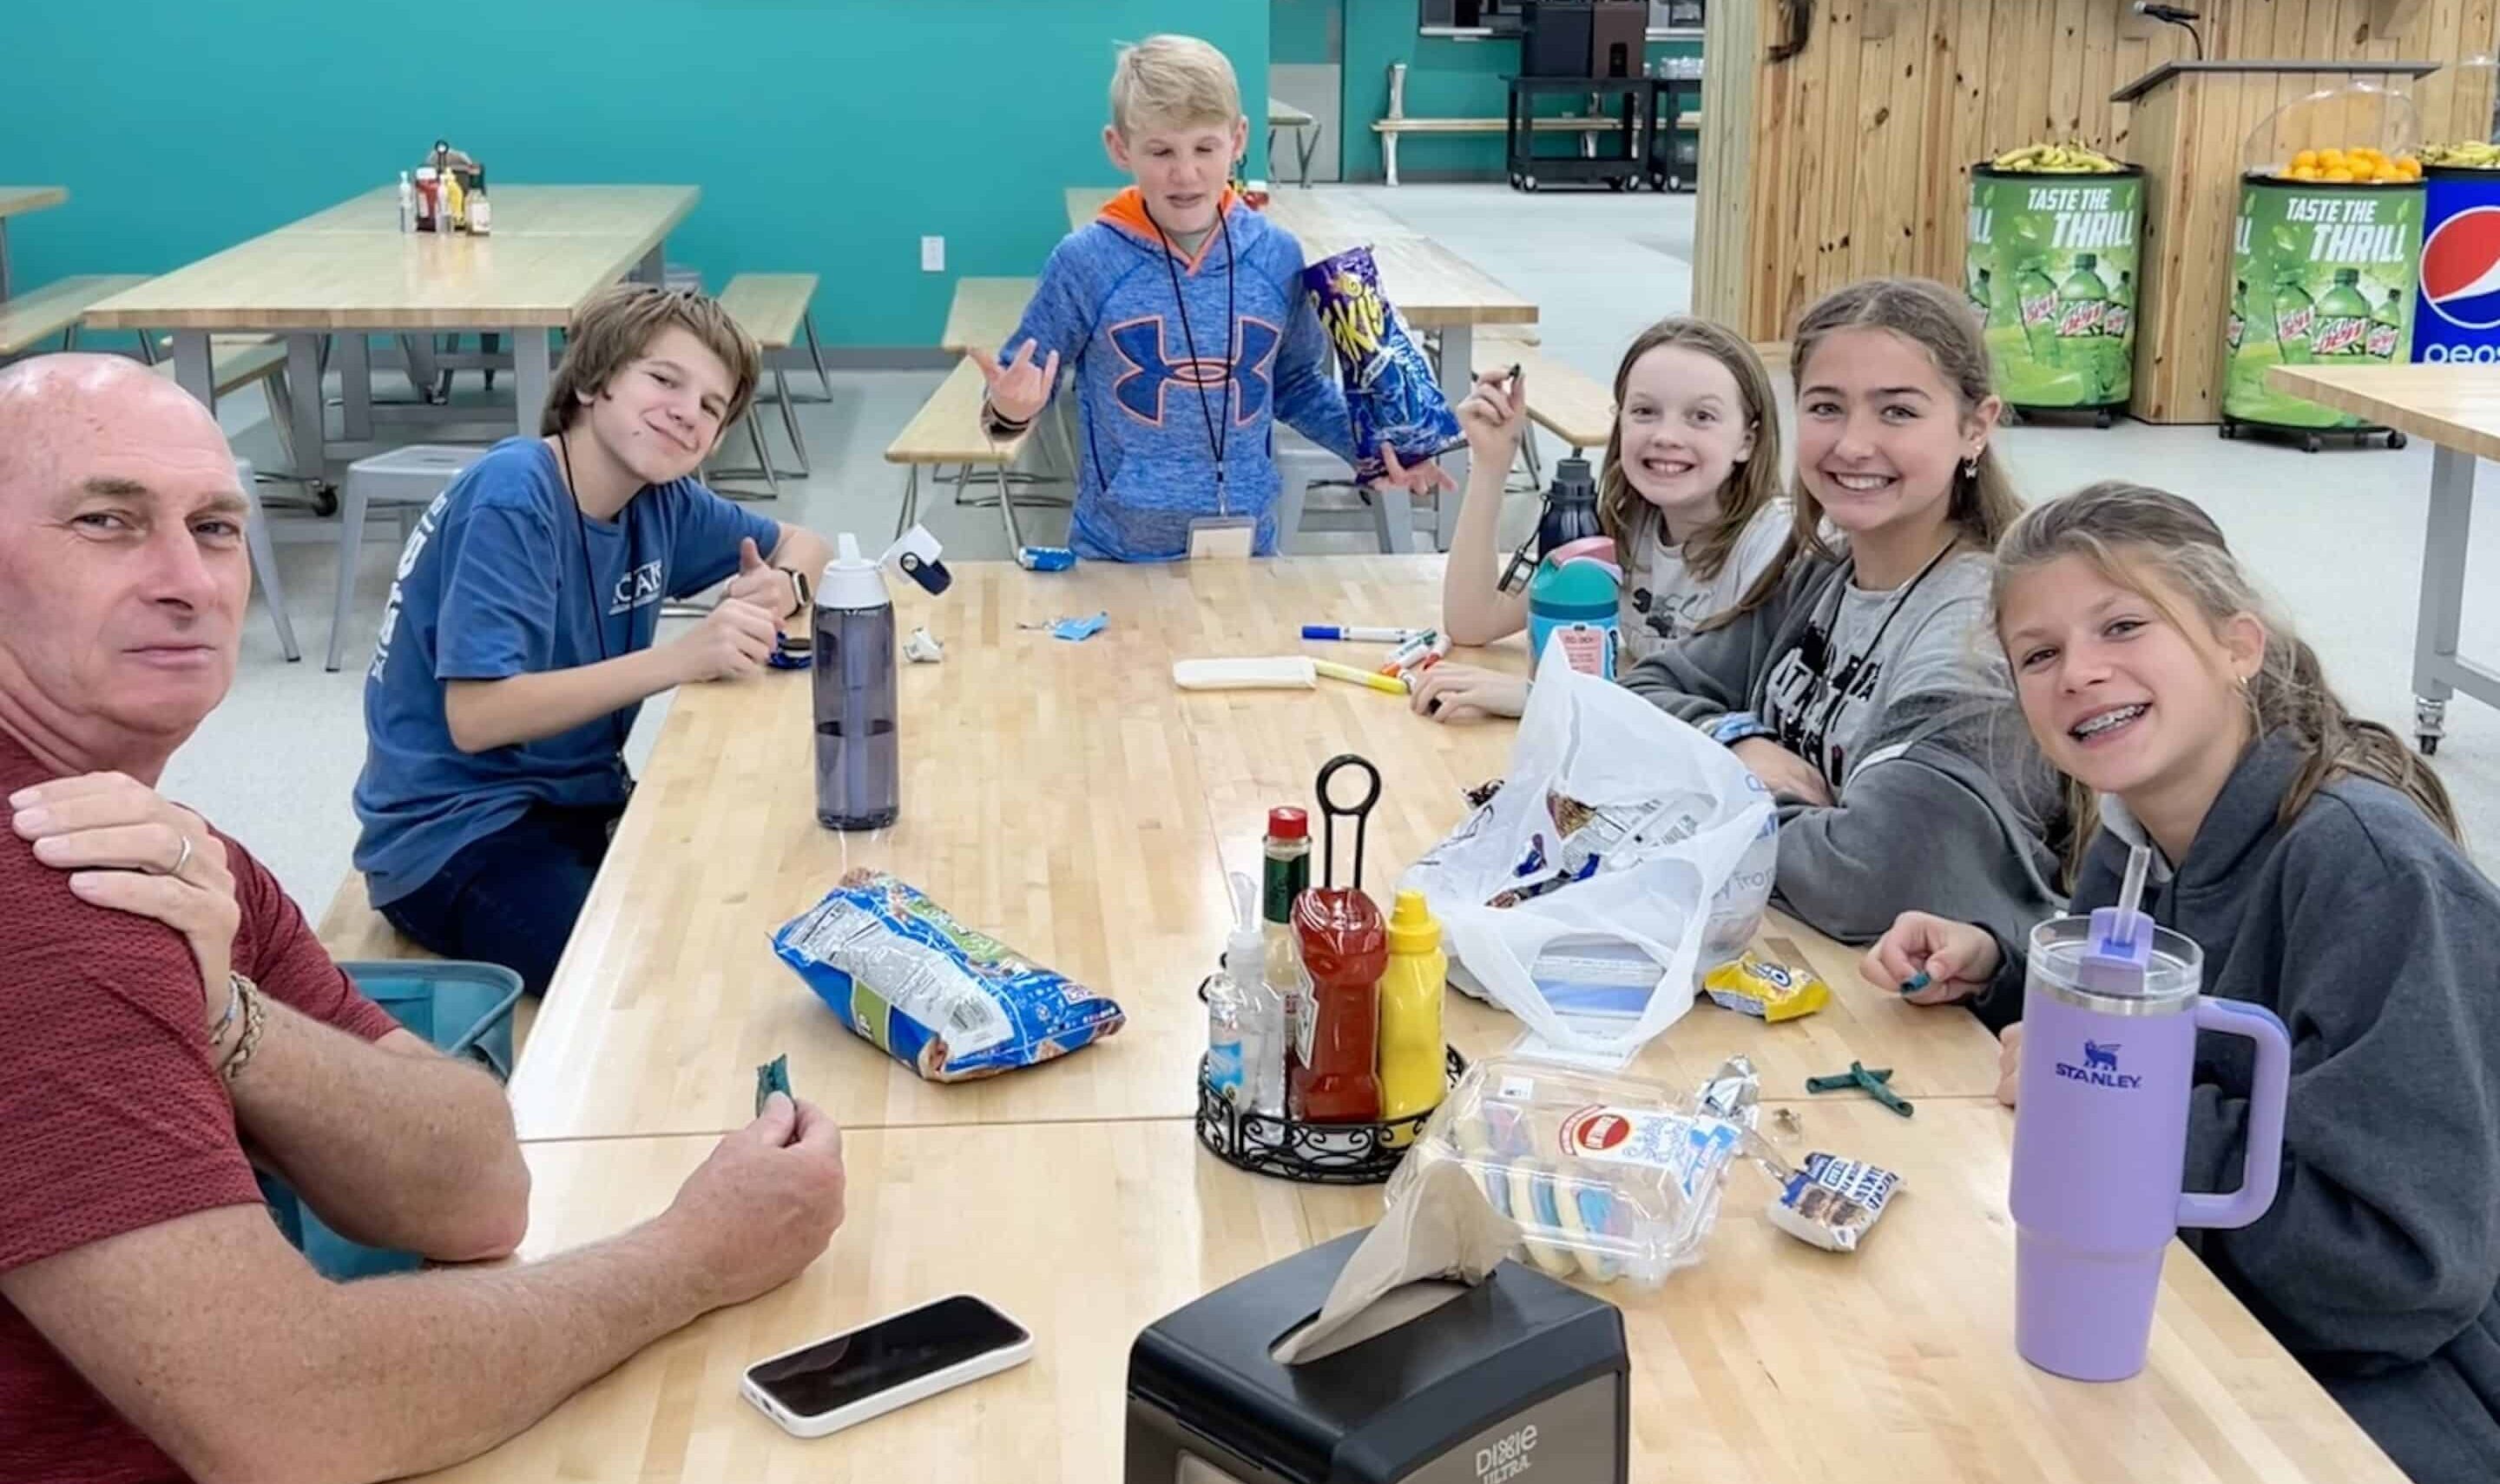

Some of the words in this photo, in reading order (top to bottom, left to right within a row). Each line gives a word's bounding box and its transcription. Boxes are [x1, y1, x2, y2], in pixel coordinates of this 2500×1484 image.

[2028, 187, 2080, 210] TASTE
[2081, 187, 2112, 210] THE
[2286, 198, 2342, 222] TASTE
[2342, 199, 2379, 223] THE
[2049, 210, 2135, 249] THRILL
[2309, 223, 2408, 263] THRILL
[2055, 1061, 2142, 1089] STANLEY
